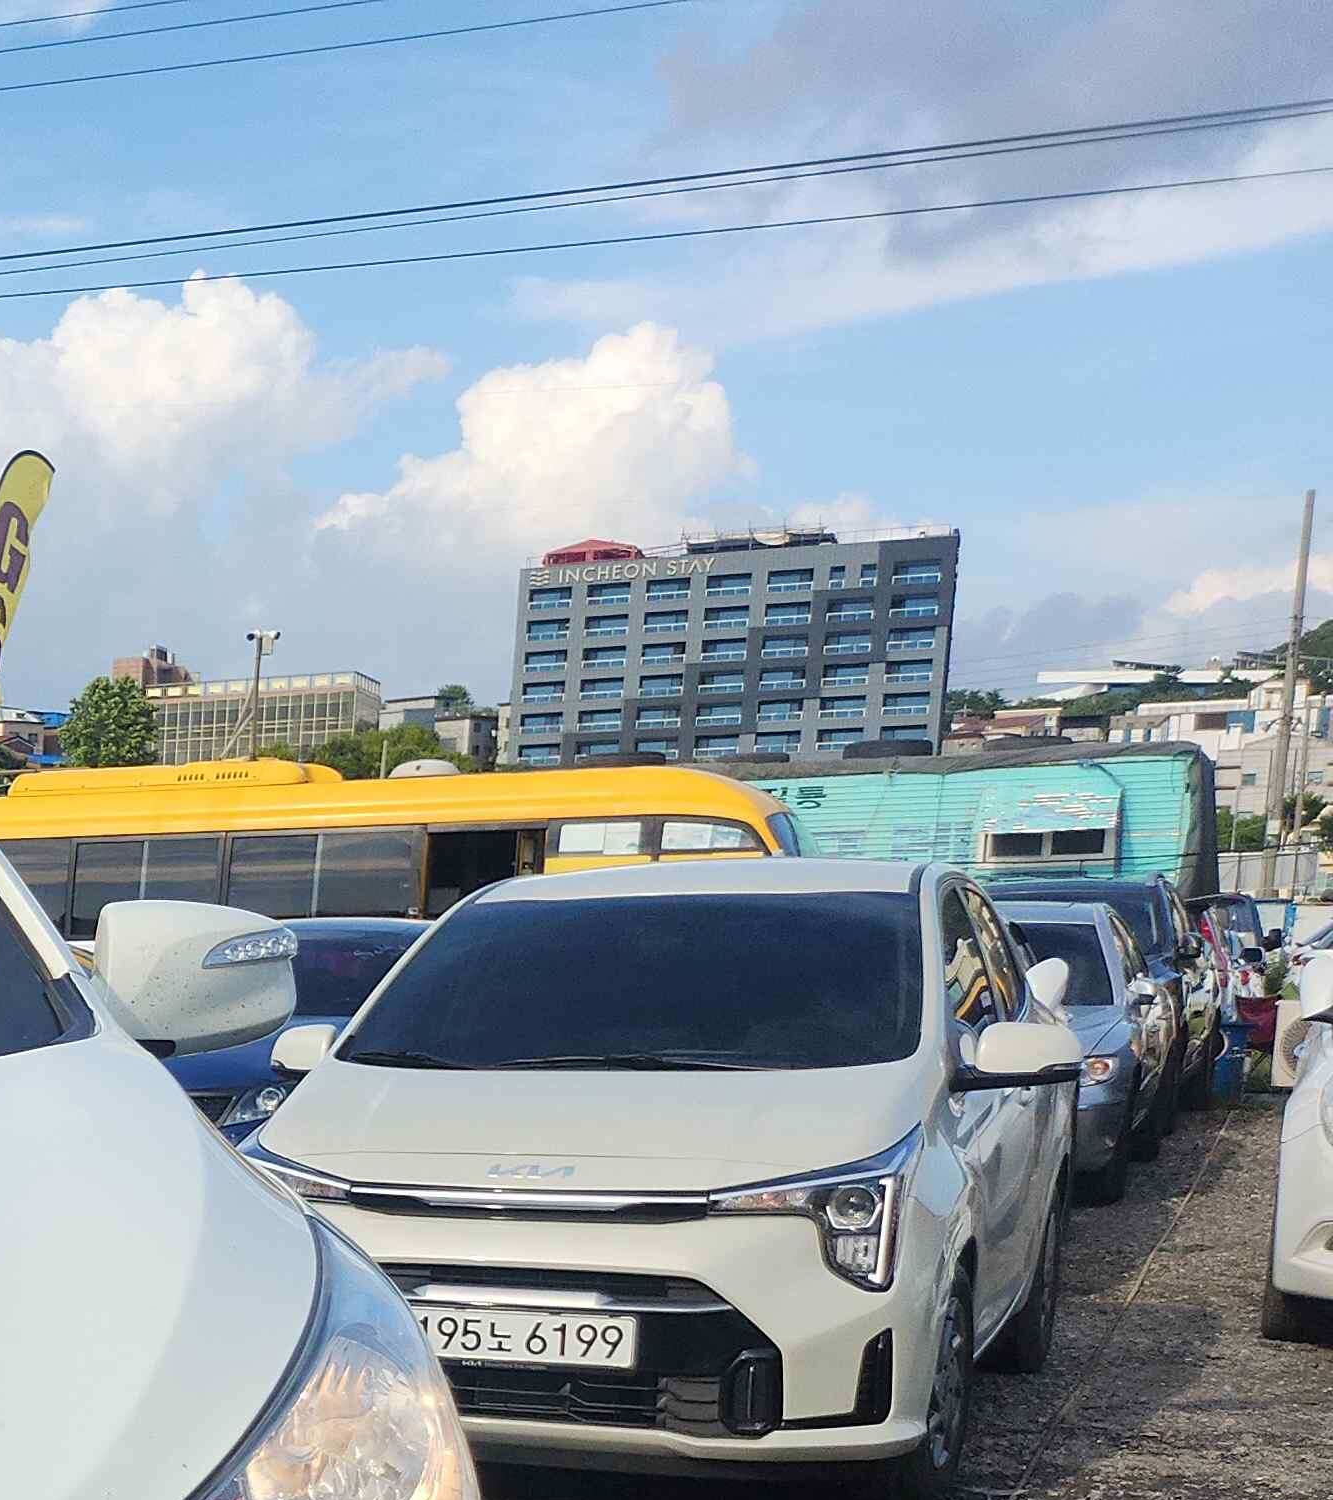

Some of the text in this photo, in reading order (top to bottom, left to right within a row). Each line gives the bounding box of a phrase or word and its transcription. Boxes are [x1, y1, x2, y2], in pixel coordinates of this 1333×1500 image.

[558, 557, 716, 583] INCHEON STAY
[419, 1316, 624, 1359] 195노 6199
